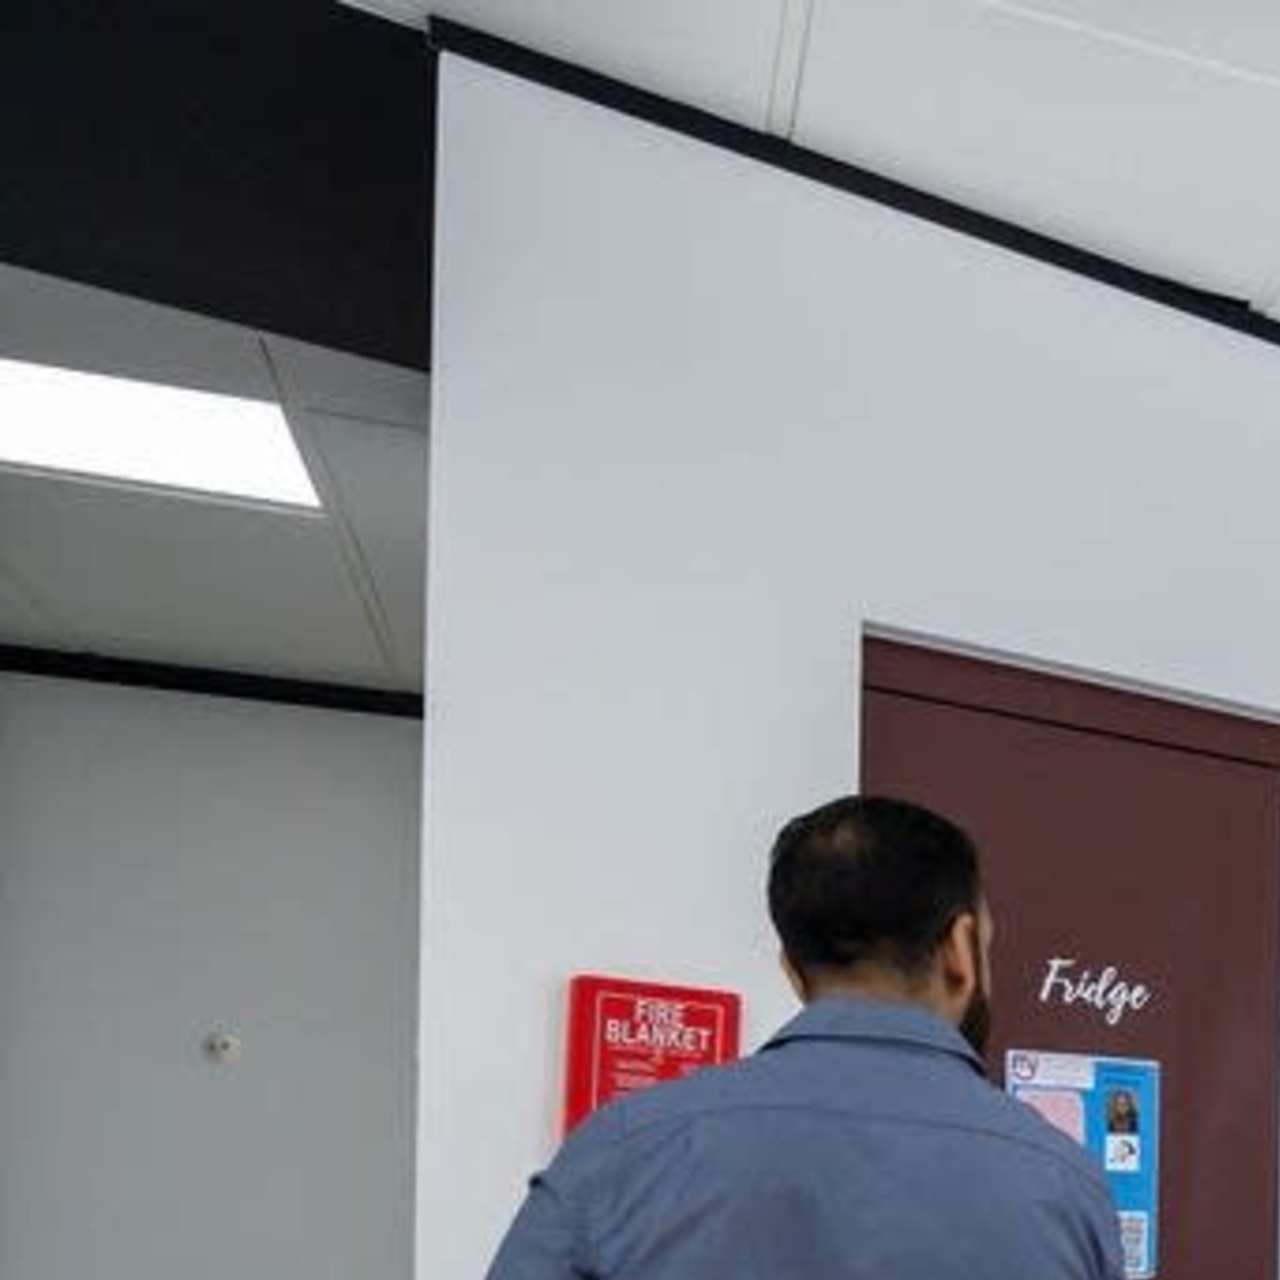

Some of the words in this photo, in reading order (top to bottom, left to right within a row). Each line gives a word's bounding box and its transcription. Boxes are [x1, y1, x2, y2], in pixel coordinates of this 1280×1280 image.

[1039, 959, 1150, 1026] Fridge
[635, 1000, 686, 1024] FIRE
[605, 1019, 712, 1051] BLANKET
